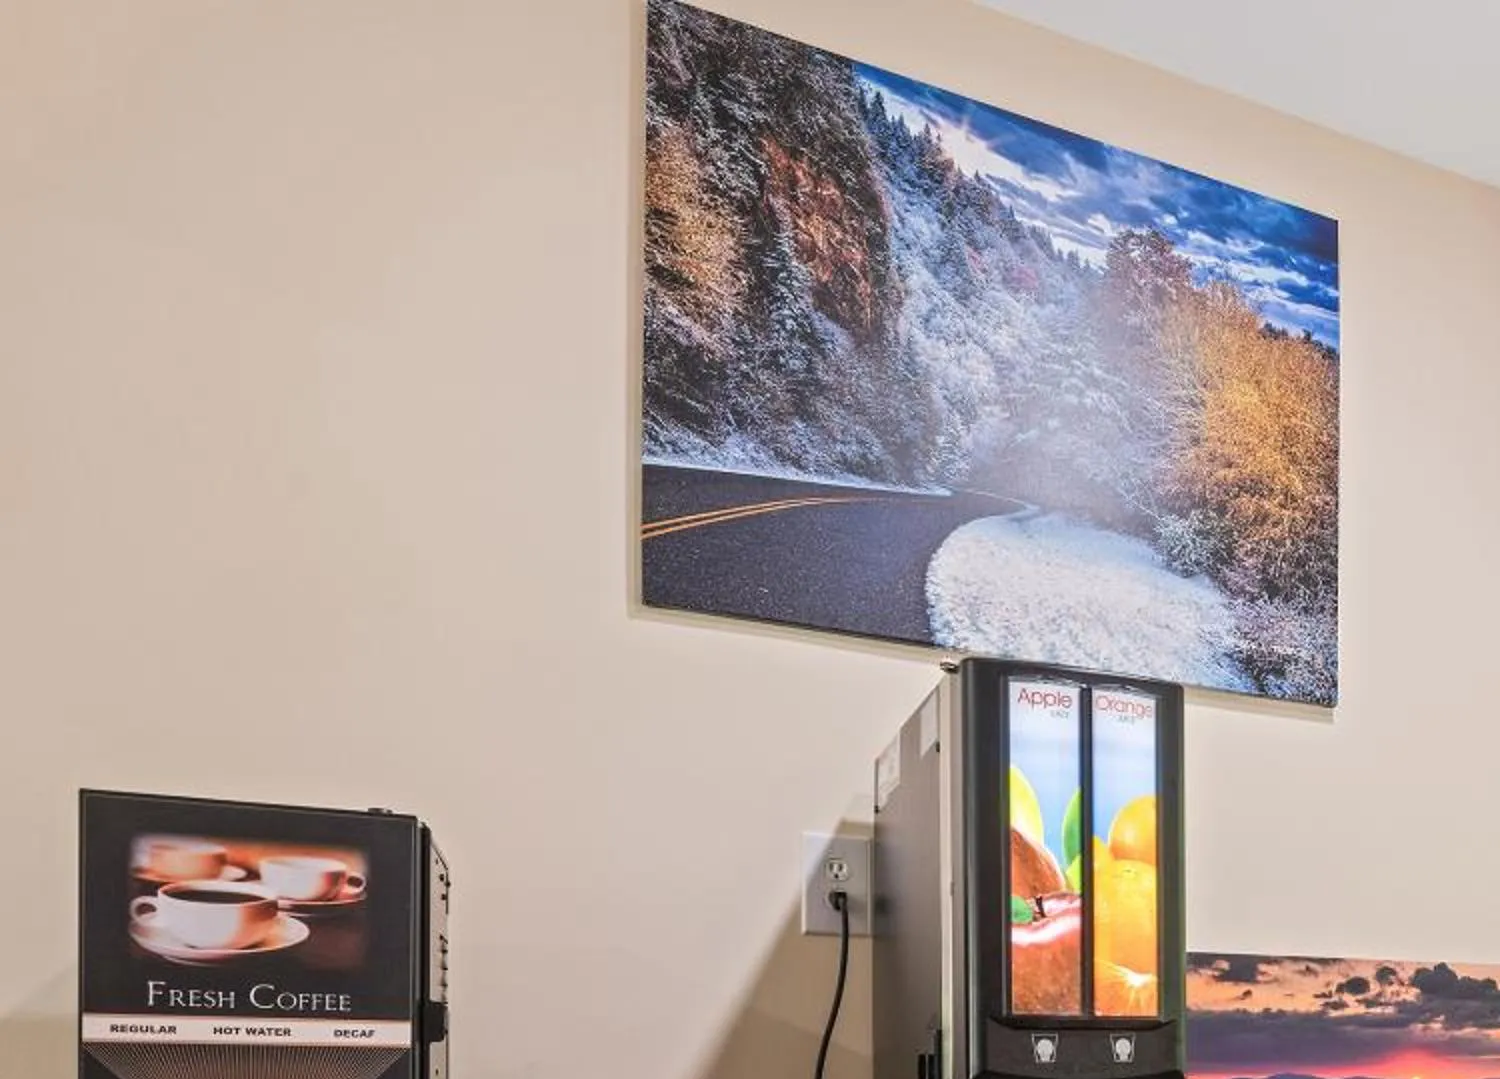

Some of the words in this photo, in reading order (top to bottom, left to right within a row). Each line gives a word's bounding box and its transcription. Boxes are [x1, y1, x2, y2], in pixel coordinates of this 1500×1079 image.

[1017, 688, 1073, 709] Apple
[1095, 695, 1153, 719] Orange
[147, 980, 236, 1009] FRESH
[249, 984, 352, 1012] COFFEE
[109, 1023, 177, 1035] REGULAR
[213, 1026, 241, 1036] HOT
[245, 1026, 292, 1037] WATER
[333, 1028, 376, 1039] DECAF
